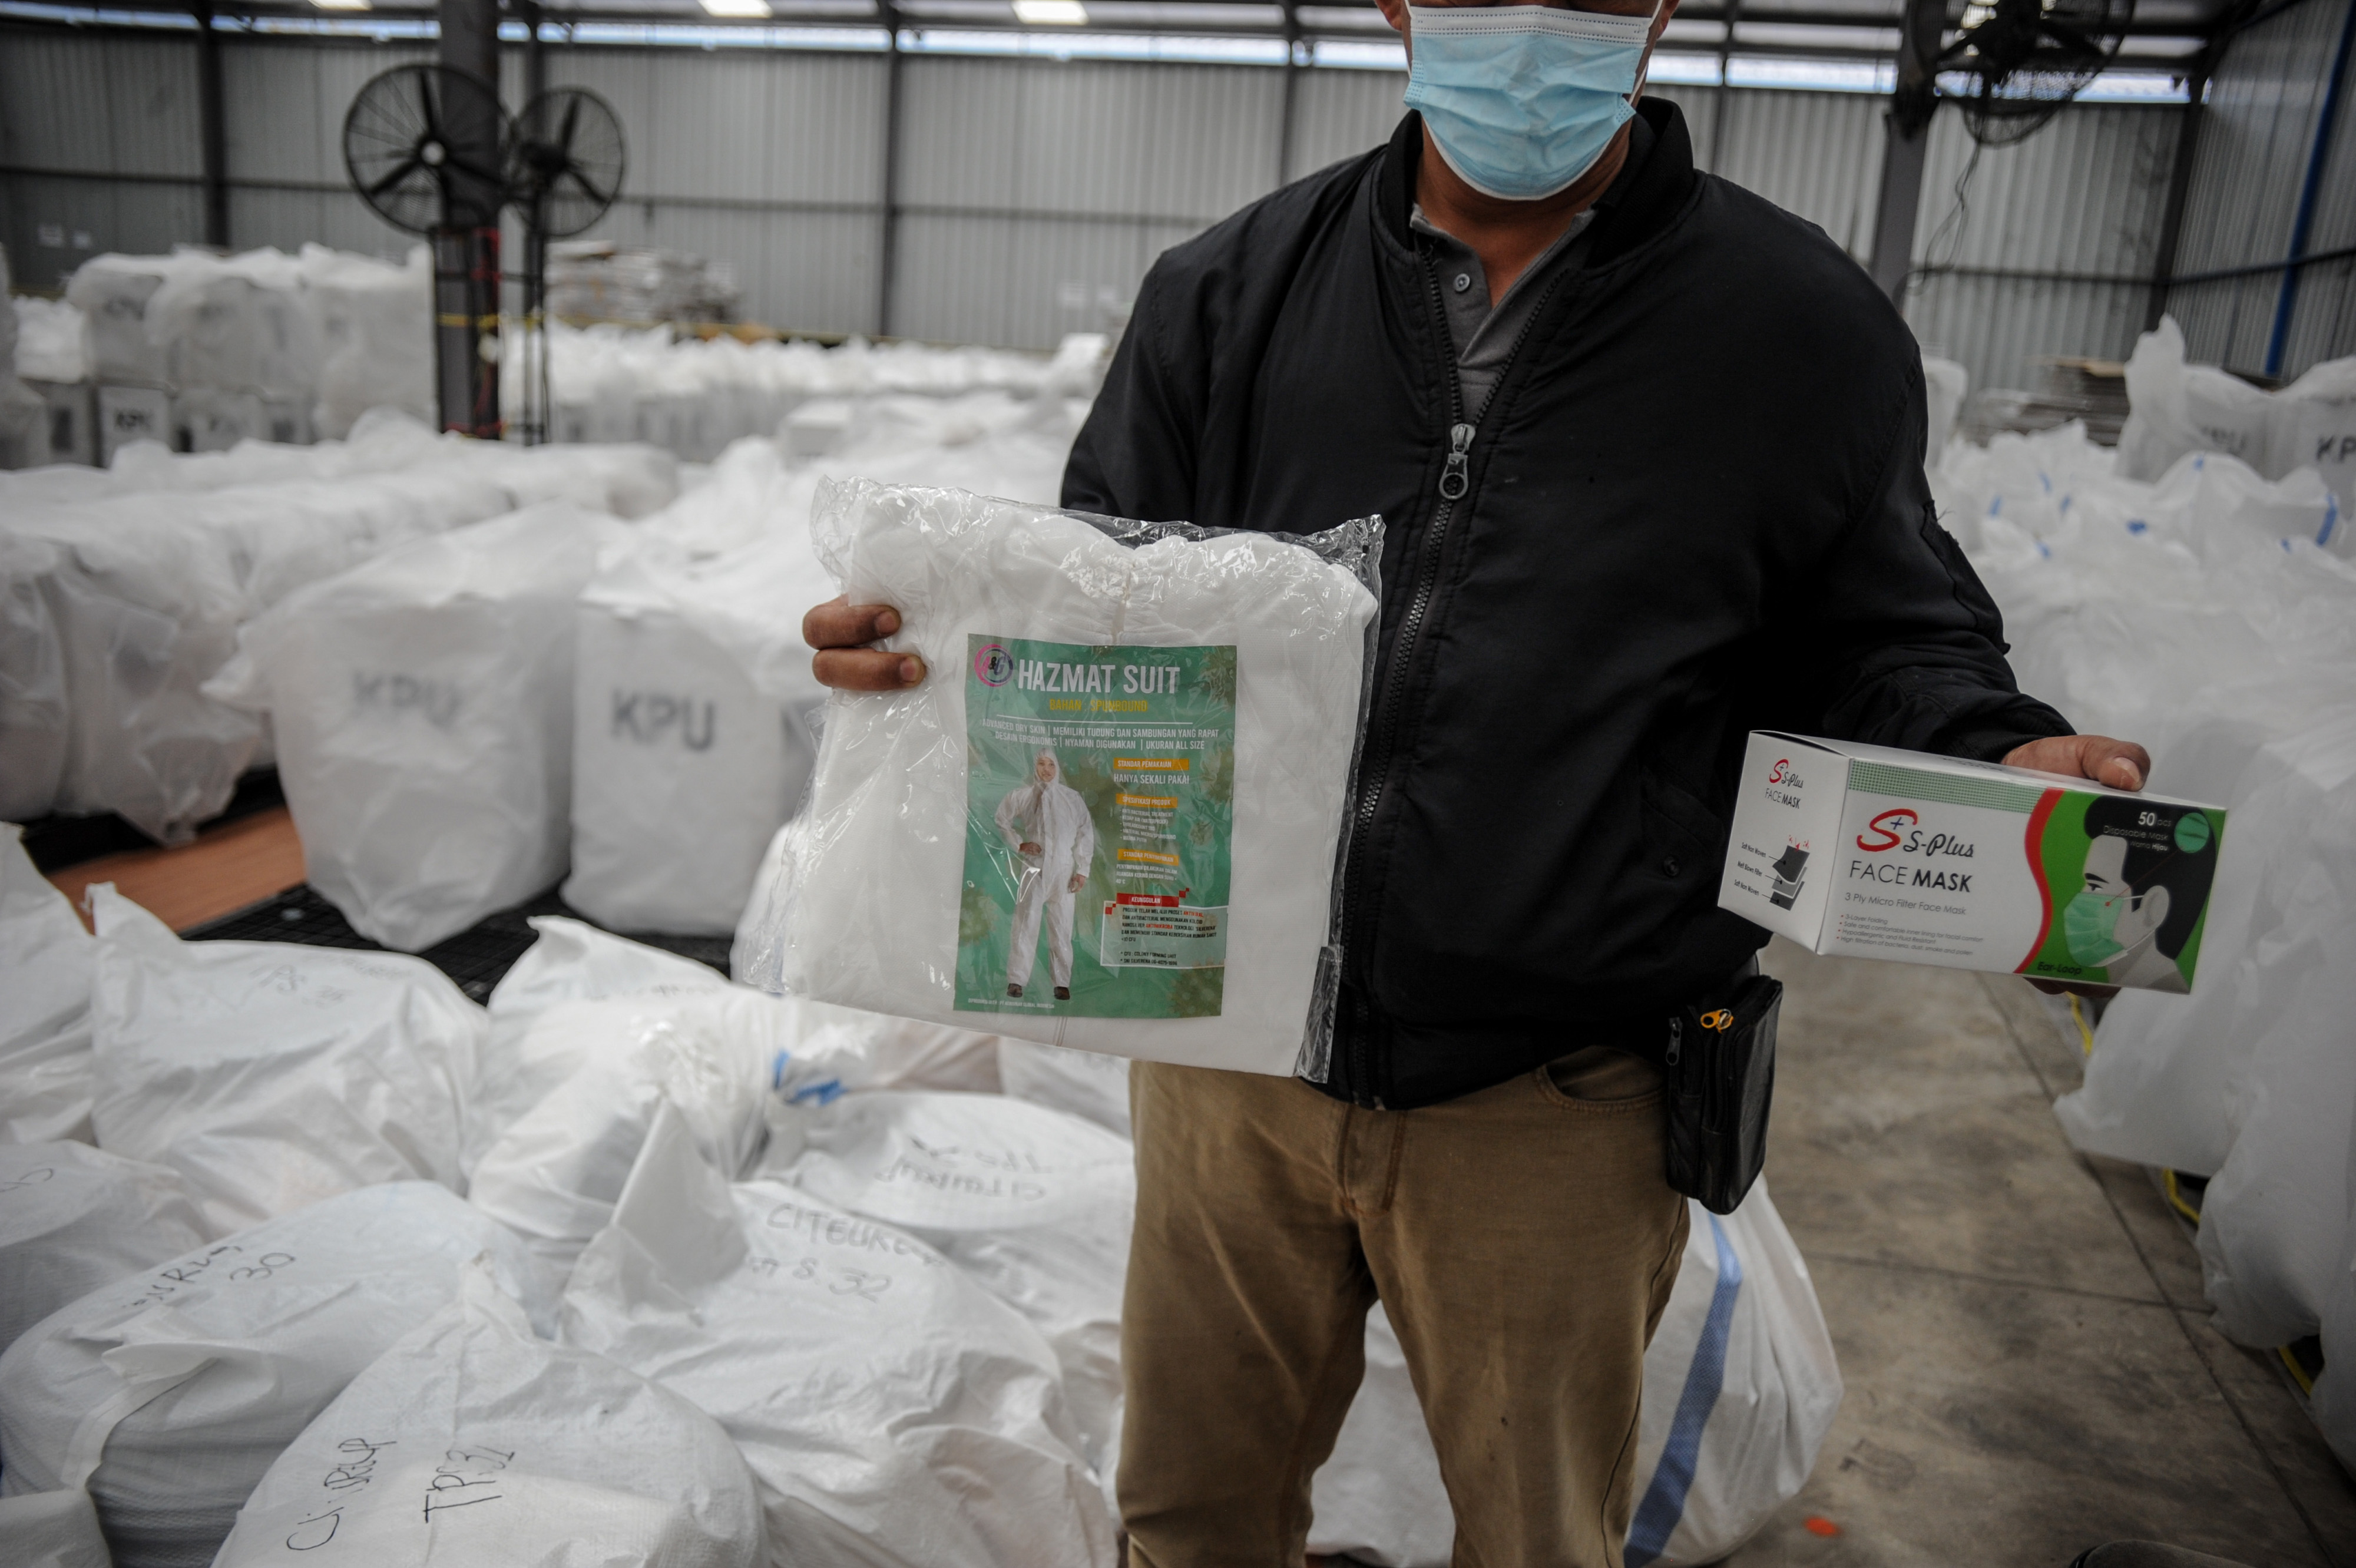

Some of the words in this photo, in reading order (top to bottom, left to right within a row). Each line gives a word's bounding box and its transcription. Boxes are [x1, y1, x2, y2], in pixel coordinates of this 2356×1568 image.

[1018, 659, 1116, 693] HAZMAT
[1123, 665, 1180, 694] SUIT
[1049, 699, 1082, 711] BAHAN
[1090, 699, 1147, 712] SPUNBOUND
[612, 687, 716, 751] KPU
[982, 718, 1014, 731] ADVANCED
[1030, 725, 1045, 734] SKIN
[1053, 727, 1085, 736] MEMILIKI
[1087, 728, 1115, 737] TUDUNG
[1117, 729, 1131, 737] DAN
[1133, 729, 1176, 738] SAMBUNGAN
[1178, 729, 1196, 738] YANG
[1198, 729, 1219, 738] RAPAT
[995, 731, 1017, 742] DESAIN
[1019, 735, 1057, 746] ERGONOMIS
[1065, 739, 1094, 748] NYAMAN
[1096, 740, 1136, 749] DIGUNAKAN
[1146, 740, 1174, 749] UKURAN
[1176, 740, 1188, 749] ALL
[1190, 740, 1205, 750] SIZE
[1114, 773, 1138, 783] HANYA
[1140, 775, 1166, 784] SEKALI
[1167, 775, 1189, 784] PAKAI
[1765, 788, 1782, 803] FACE
[1782, 794, 1801, 810] MASK
[2137, 811, 2156, 826] 50
[2103, 825, 2147, 838] Disposable
[2148, 832, 2169, 841] Mask
[1903, 831, 1974, 858] S-Plus
[2152, 843, 2169, 852] Hijau
[1849, 860, 1908, 885] FACE
[1911, 868, 1973, 893] MASK
[1844, 892, 1851, 901] 3
[1853, 893, 1867, 904] Ply
[1868, 896, 1894, 907] Micro
[1896, 899, 1917, 909] Filter
[1918, 902, 1941, 912] Face
[1943, 905, 1967, 915] Mask
[1845, 913, 1867, 922] 3-Layer
[1867, 916, 1888, 925] Folding
[1842, 928, 1884, 939] Hypoallergenic
[1871, 924, 1905, 934] comfortable
[1841, 935, 1854, 944] High
[1854, 937, 1877, 945] filtration
[1956, 948, 1973, 957] pollen
[2037, 961, 2082, 976] Ear-Loop
[229, 1252, 296, 1281] 30
